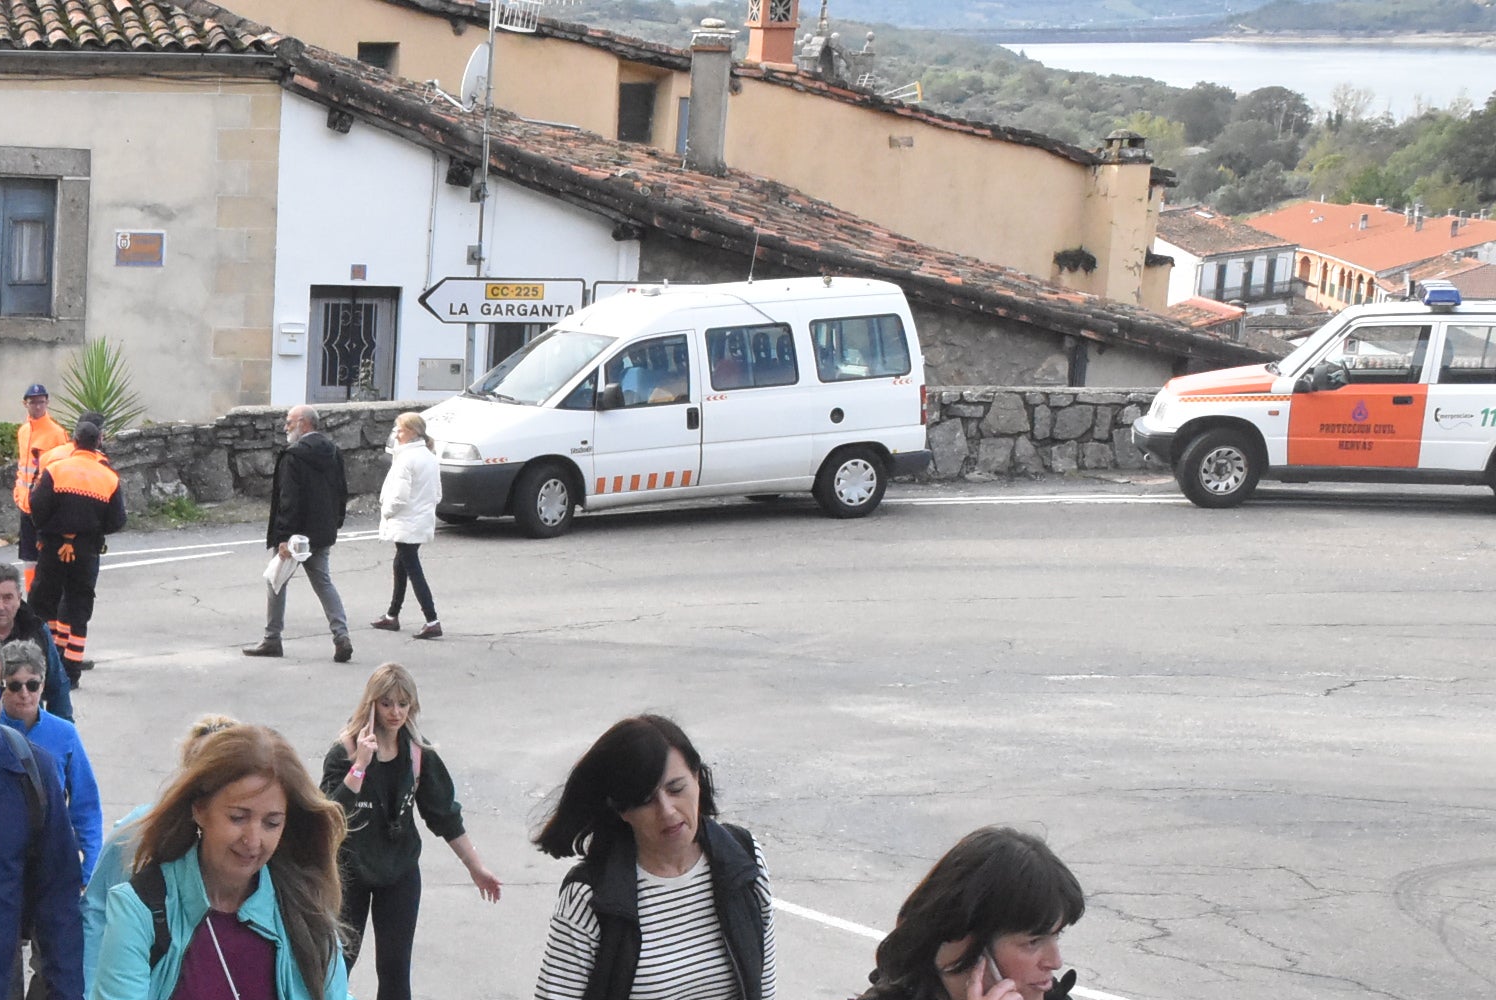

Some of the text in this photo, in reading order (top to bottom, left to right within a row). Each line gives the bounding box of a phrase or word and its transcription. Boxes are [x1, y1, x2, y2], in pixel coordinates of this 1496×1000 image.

[490, 286, 539, 297] CC-225
[449, 303, 574, 317] LA GARGANTA
[1373, 424, 1396, 434] CIVIL
